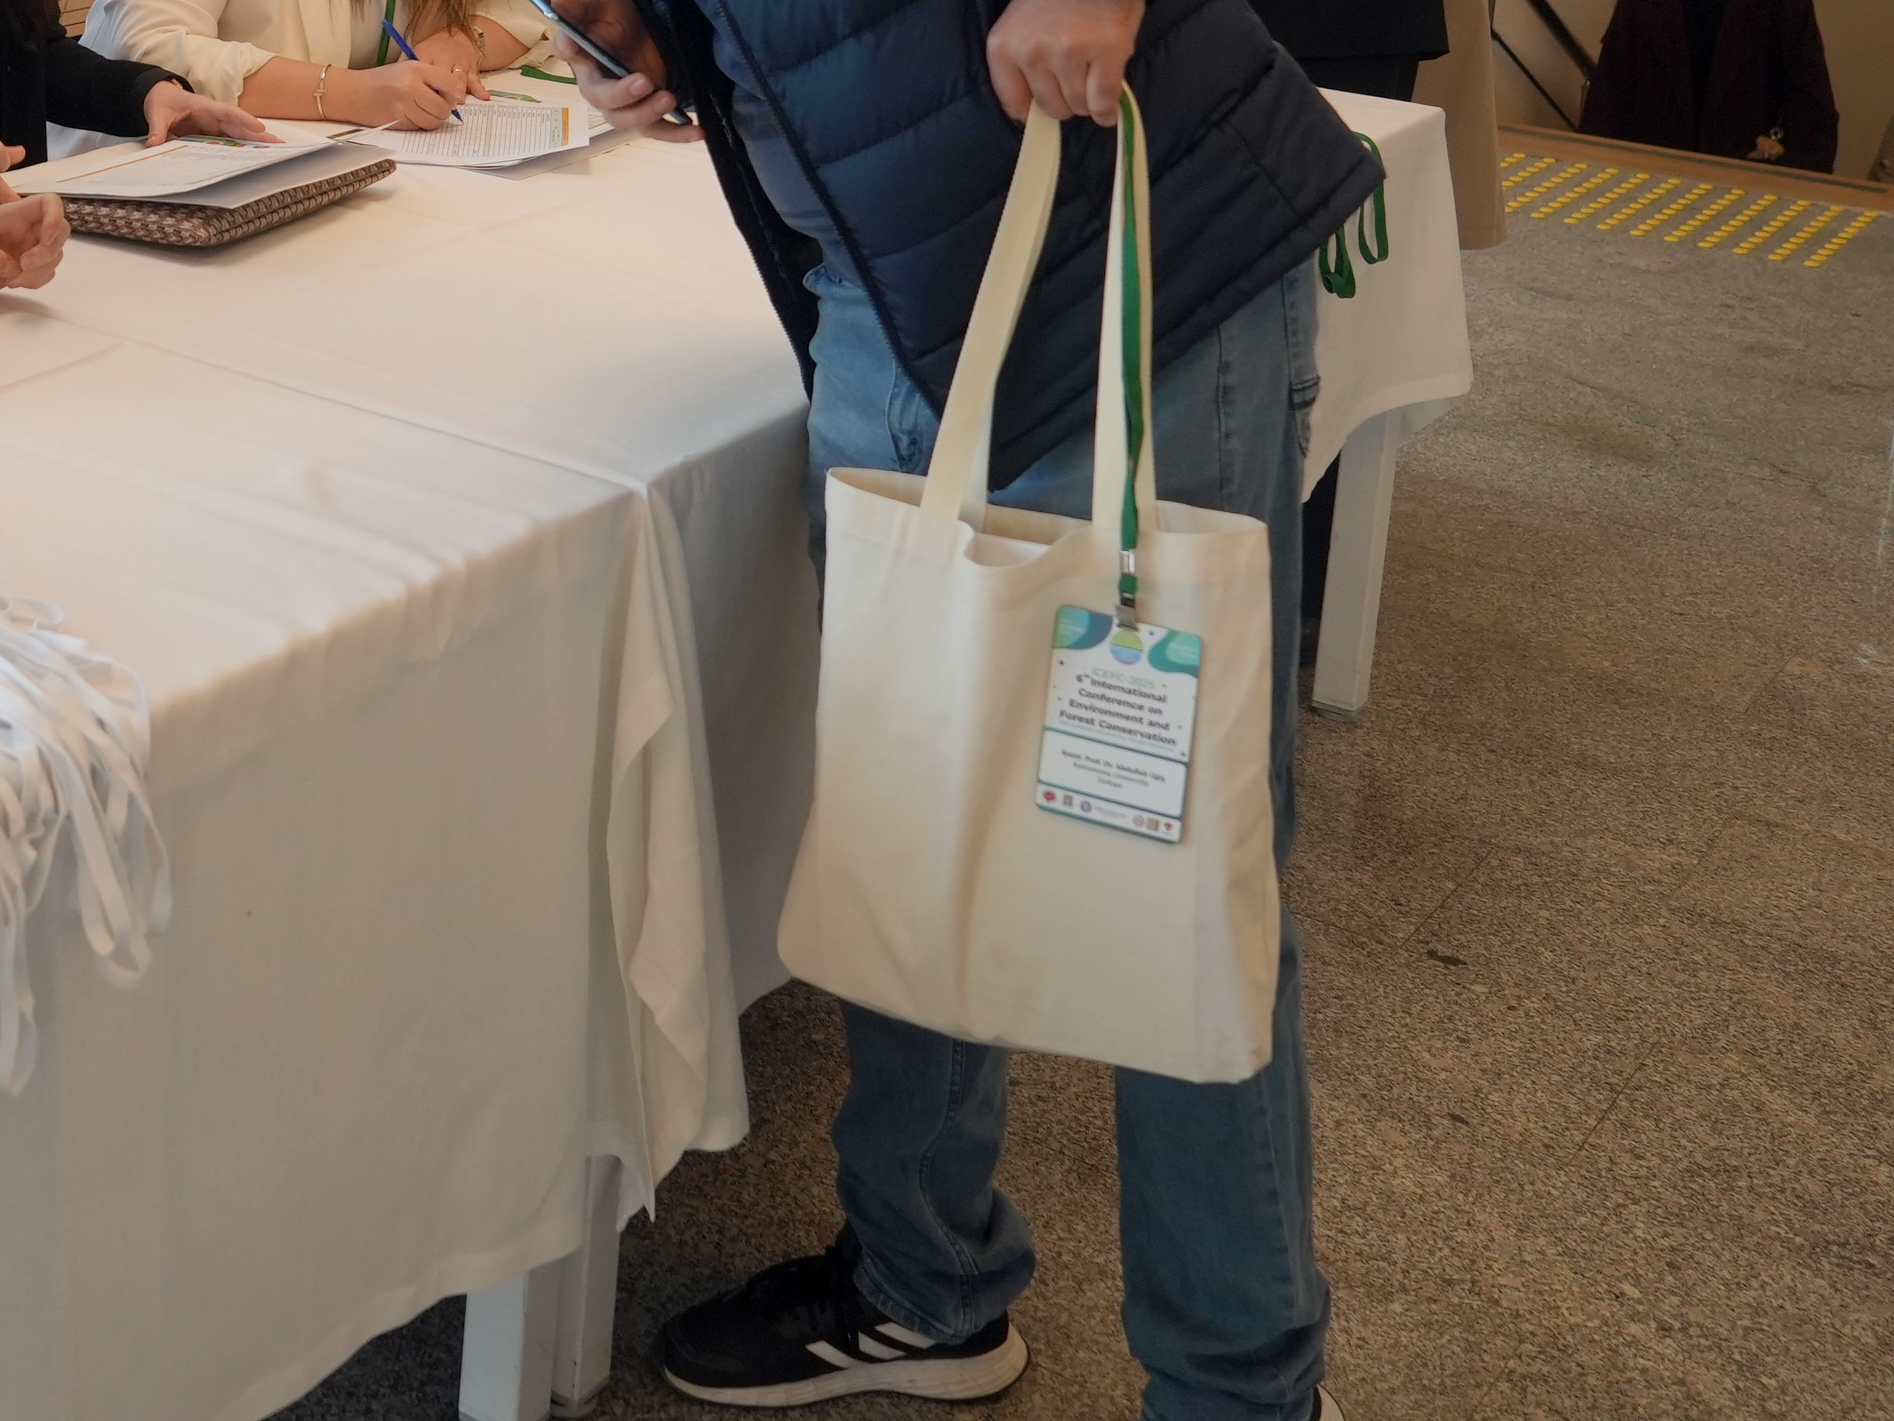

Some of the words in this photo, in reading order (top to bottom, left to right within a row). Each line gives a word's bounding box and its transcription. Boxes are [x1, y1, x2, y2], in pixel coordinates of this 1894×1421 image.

[1077, 687, 1145, 712] Conference
[1146, 705, 1164, 716] on
[1090, 677, 1168, 704] International
[1059, 709, 1096, 726] Forest
[1097, 719, 1178, 746] Conservation
[1068, 698, 1145, 725] Environment
[1146, 719, 1171, 732] and
